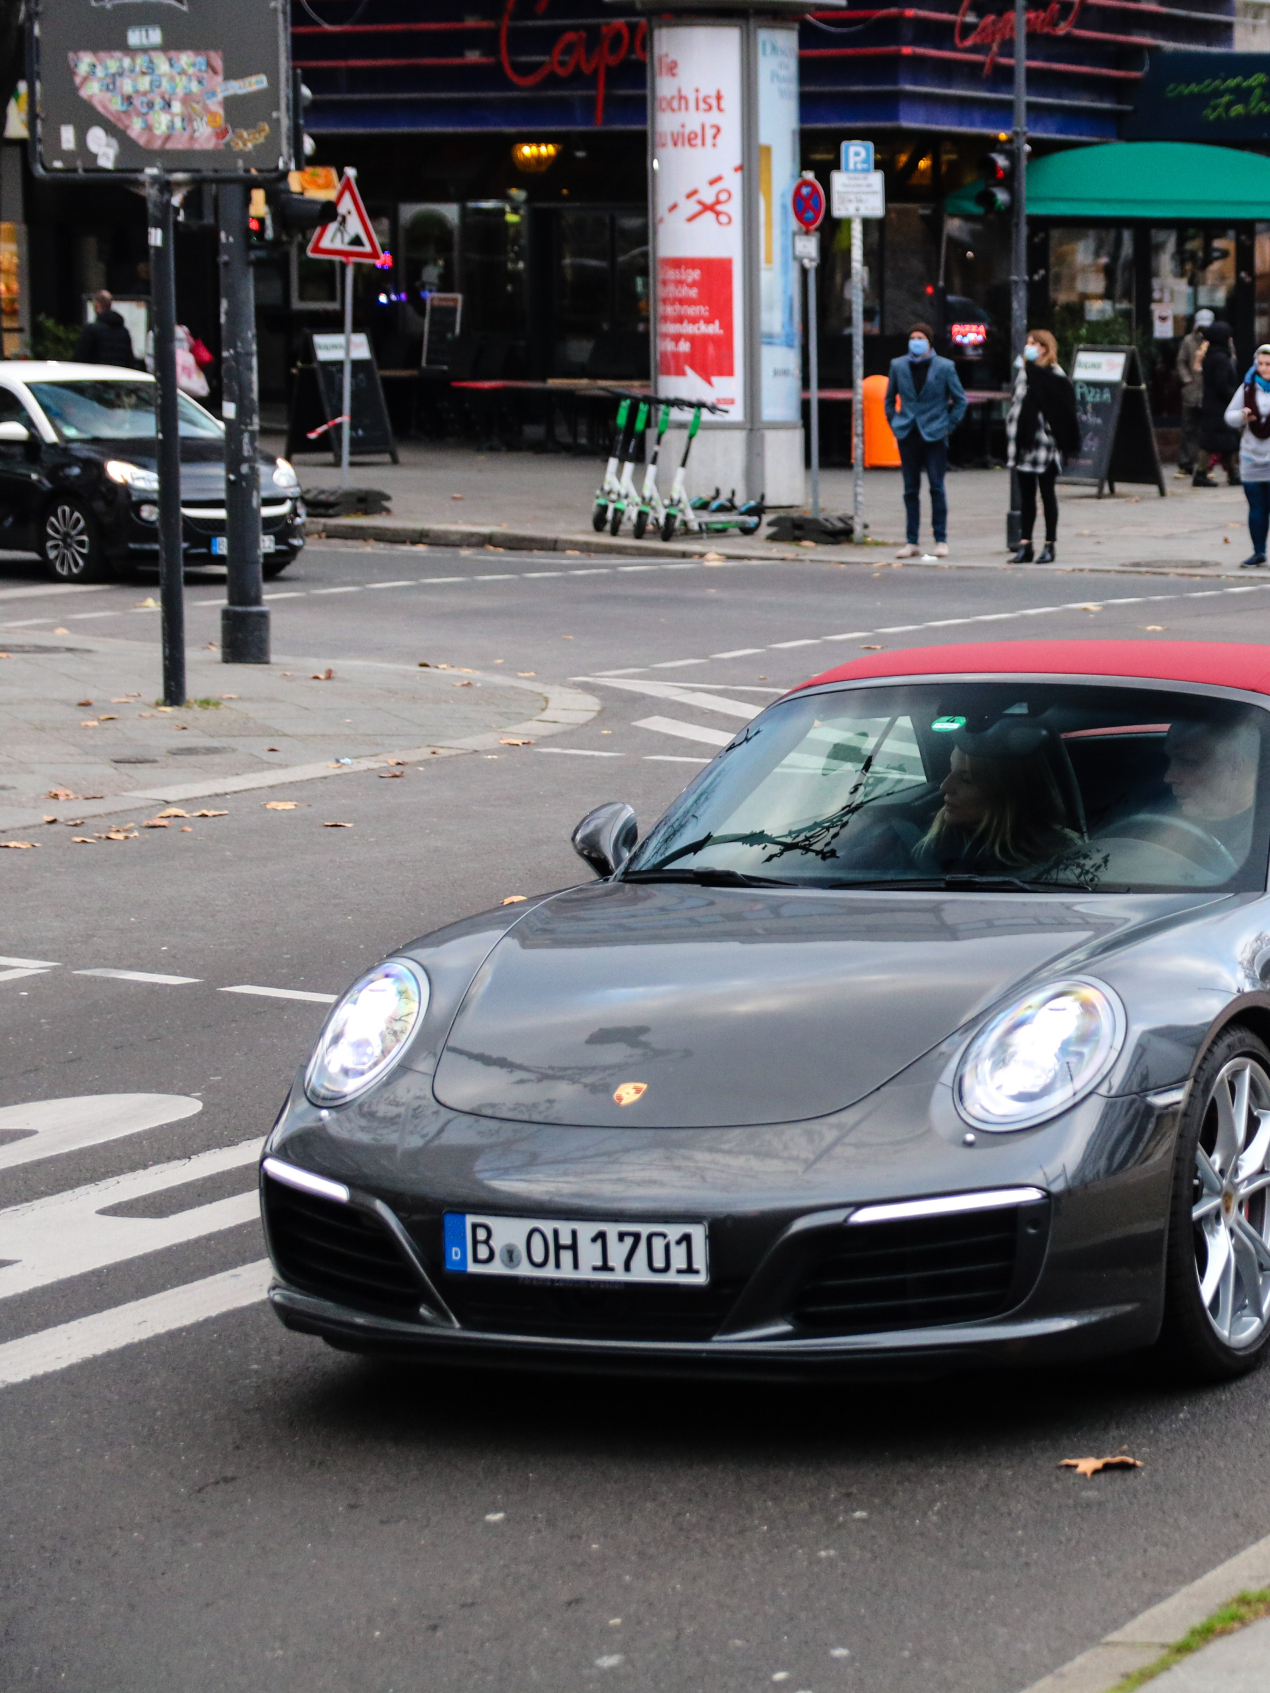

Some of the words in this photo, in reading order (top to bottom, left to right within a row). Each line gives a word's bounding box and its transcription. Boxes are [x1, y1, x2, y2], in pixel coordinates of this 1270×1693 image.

[694, 88, 724, 112] ist
[670, 122, 721, 148] viel?
[848, 145, 867, 170] P
[452, 1247, 460, 1260] D
[471, 1222, 496, 1264] B
[526, 1226, 579, 1270] OH
[590, 1229, 700, 1275] 1701
